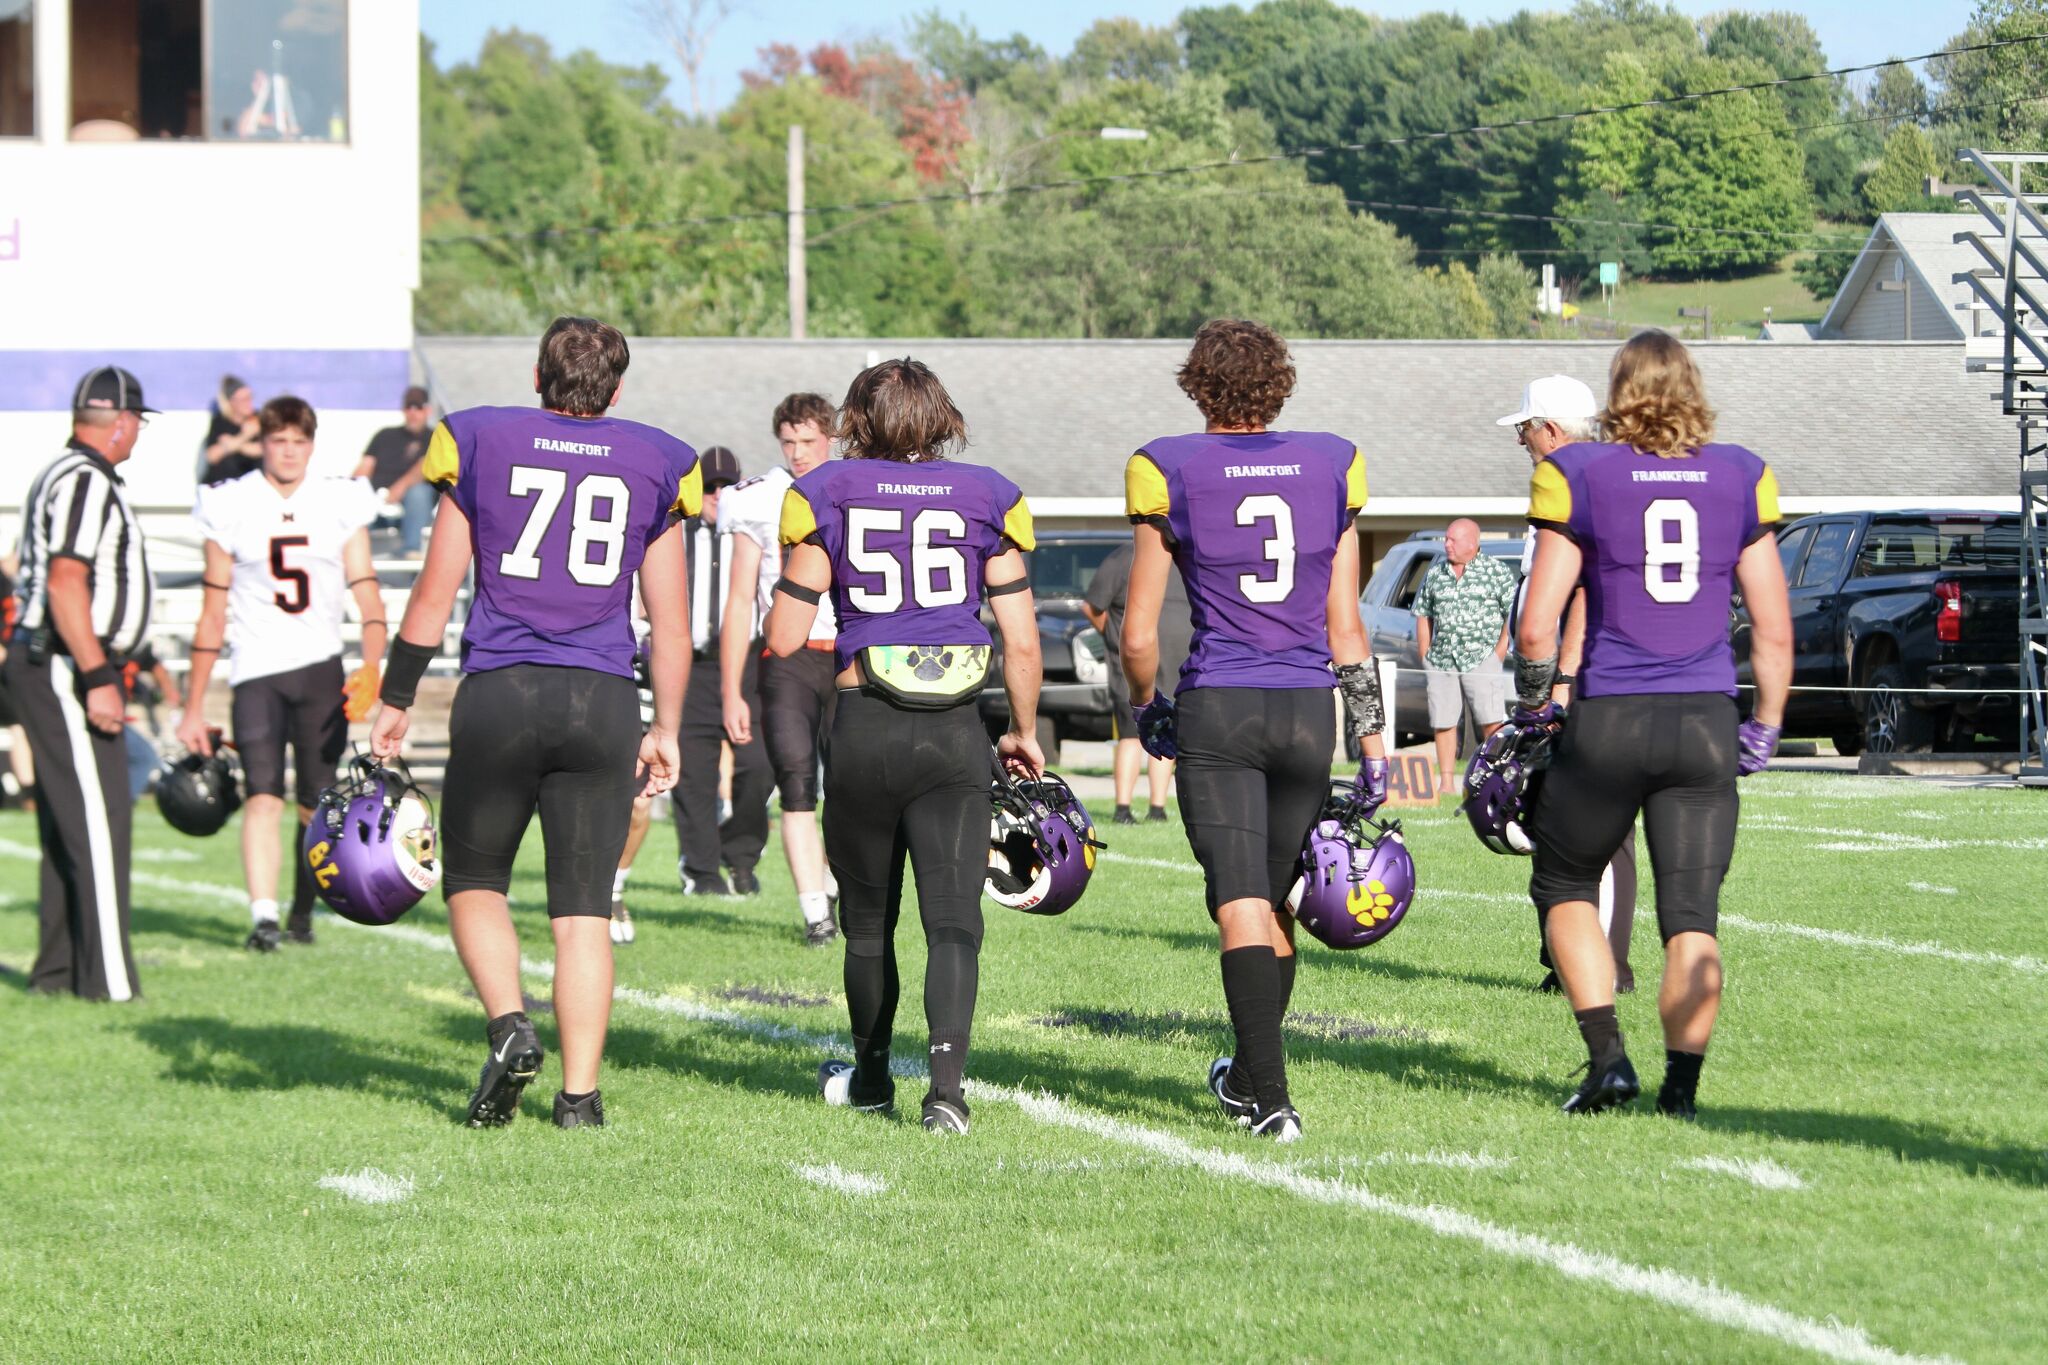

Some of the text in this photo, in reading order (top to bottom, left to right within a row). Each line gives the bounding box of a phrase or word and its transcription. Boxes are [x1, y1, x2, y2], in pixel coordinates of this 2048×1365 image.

[534, 437, 611, 457] FRANKFORT
[1224, 464, 1301, 478] FRANKFORT
[877, 483, 953, 496] FRANKFORT
[1632, 470, 1709, 482] FRANKFORT
[498, 464, 632, 588] 78
[1234, 494, 1297, 604] 3
[269, 535, 310, 614] 5
[846, 506, 968, 614] 56
[1643, 498, 1700, 604] 8
[1386, 756, 1434, 799] 40
[308, 841, 340, 890] 78
